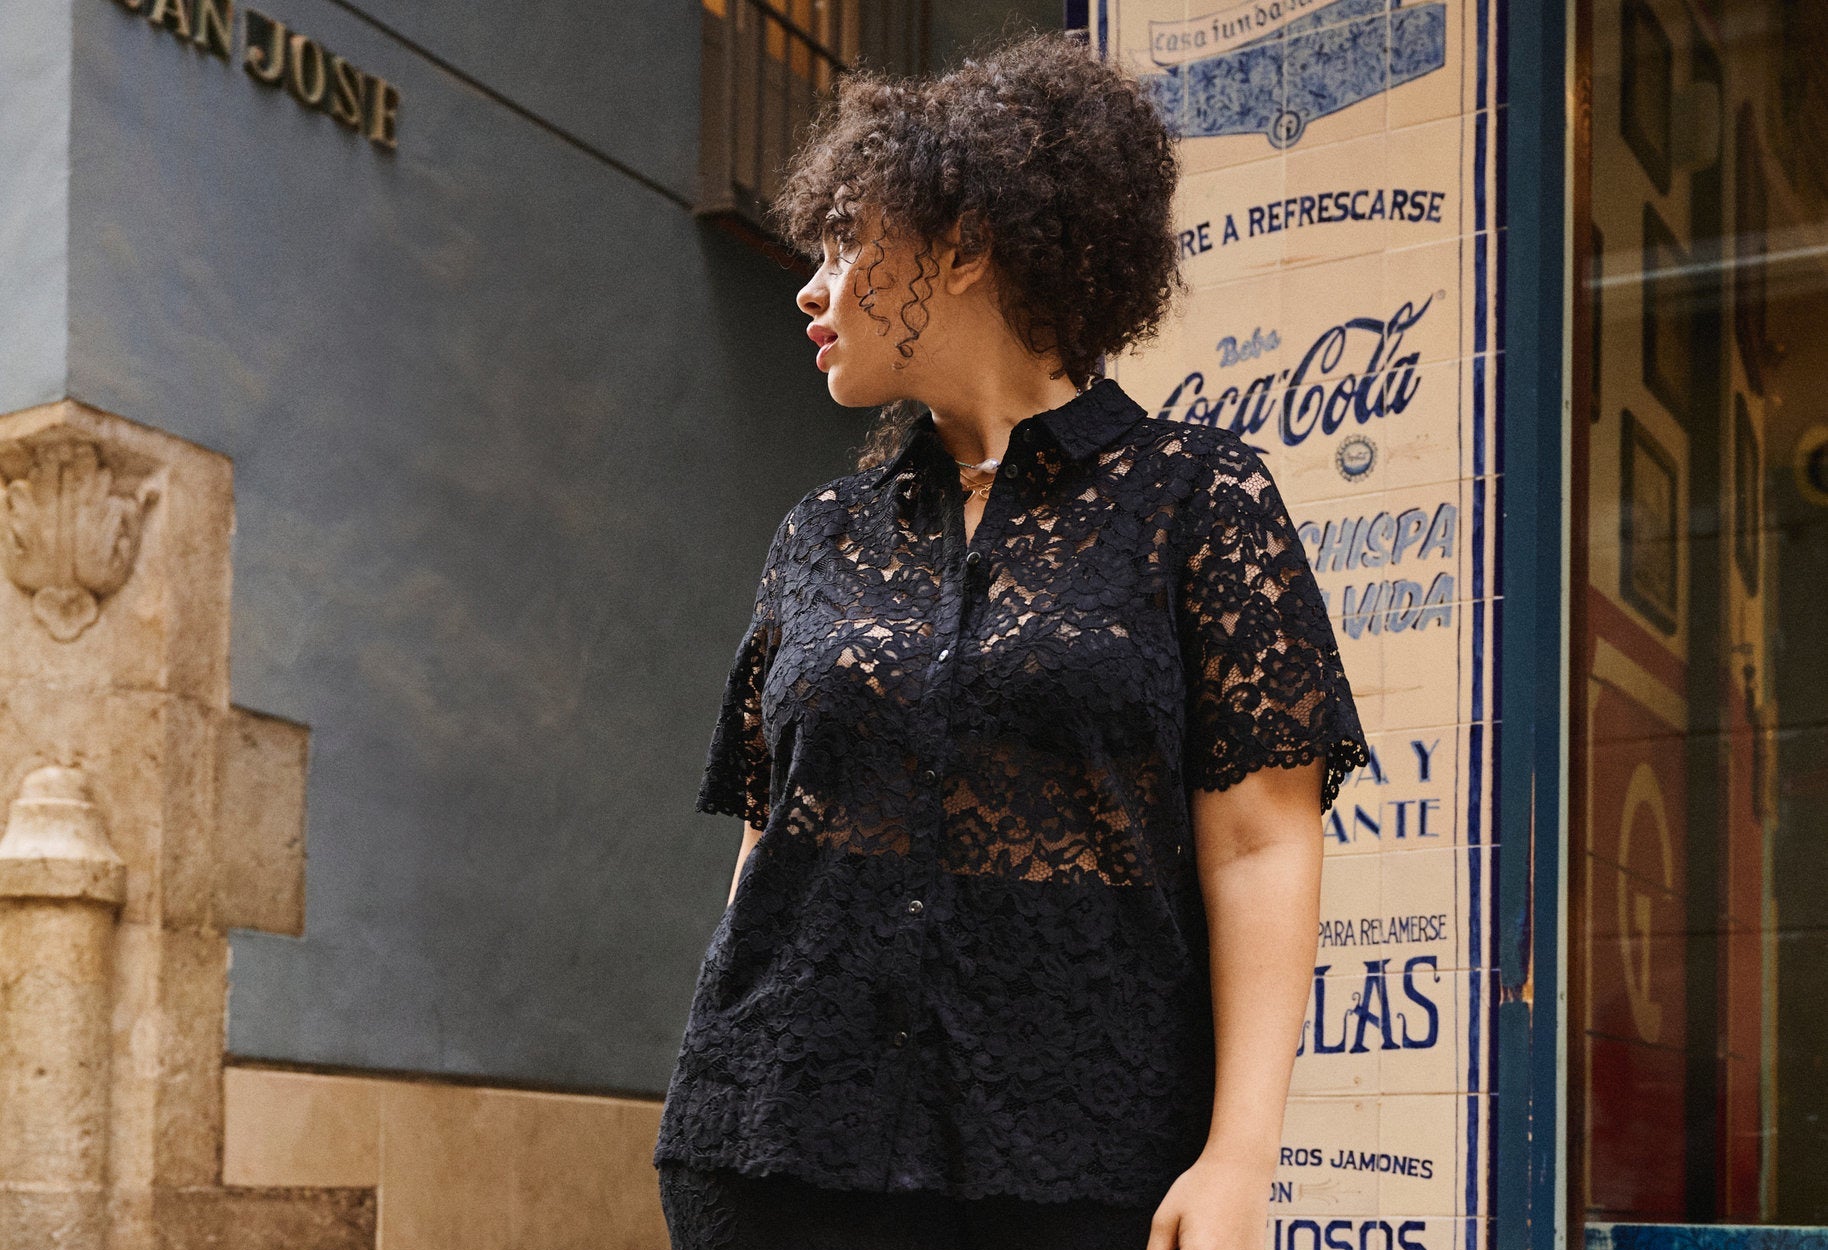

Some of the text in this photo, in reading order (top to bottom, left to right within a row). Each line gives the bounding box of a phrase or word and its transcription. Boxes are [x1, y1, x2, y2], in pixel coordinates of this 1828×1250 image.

[116, 0, 234, 64] AN
[1179, 189, 1446, 260] RE A REFRESCARSE
[1297, 502, 1457, 573] CHISPA
[1342, 571, 1454, 640] VIDA
[1341, 739, 1440, 788] A Y
[1323, 799, 1440, 843] ANTE
[1360, 915, 1447, 946] RELAMERSE
[1296, 955, 1441, 1057] LAS
[1280, 1147, 1433, 1180] ROS JAMONES
